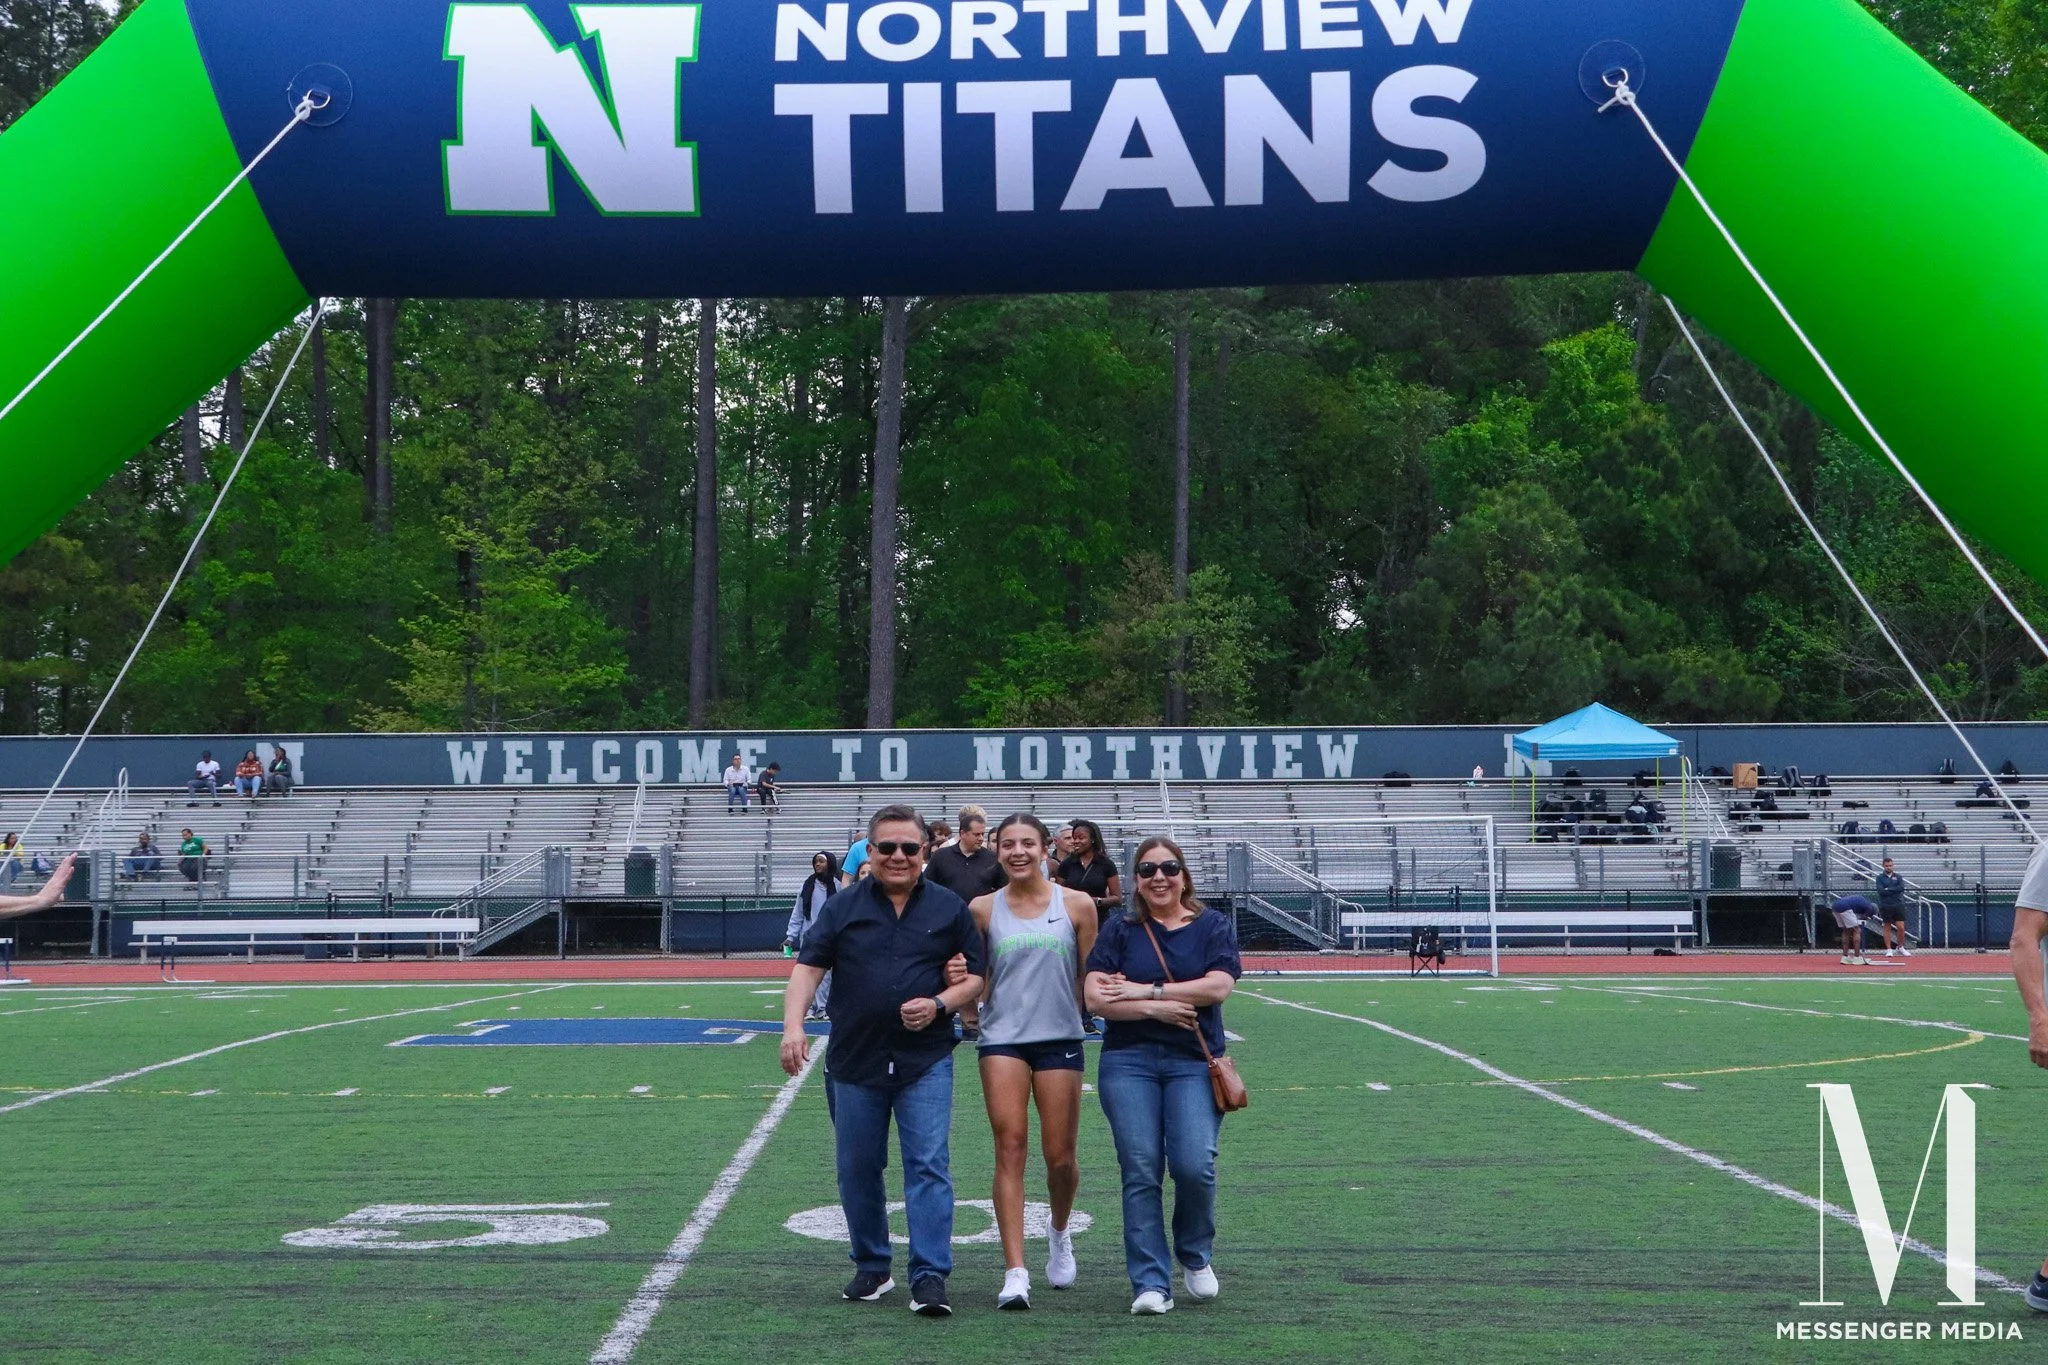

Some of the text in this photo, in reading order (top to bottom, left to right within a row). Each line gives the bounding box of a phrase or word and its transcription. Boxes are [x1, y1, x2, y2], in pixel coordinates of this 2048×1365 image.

[774, 0, 1475, 62] NORTHVIEW
[442, 2, 702, 217] N
[773, 64, 1488, 215] TITANS
[446, 735, 1359, 785] WELCOME TO NORTHVIEW
